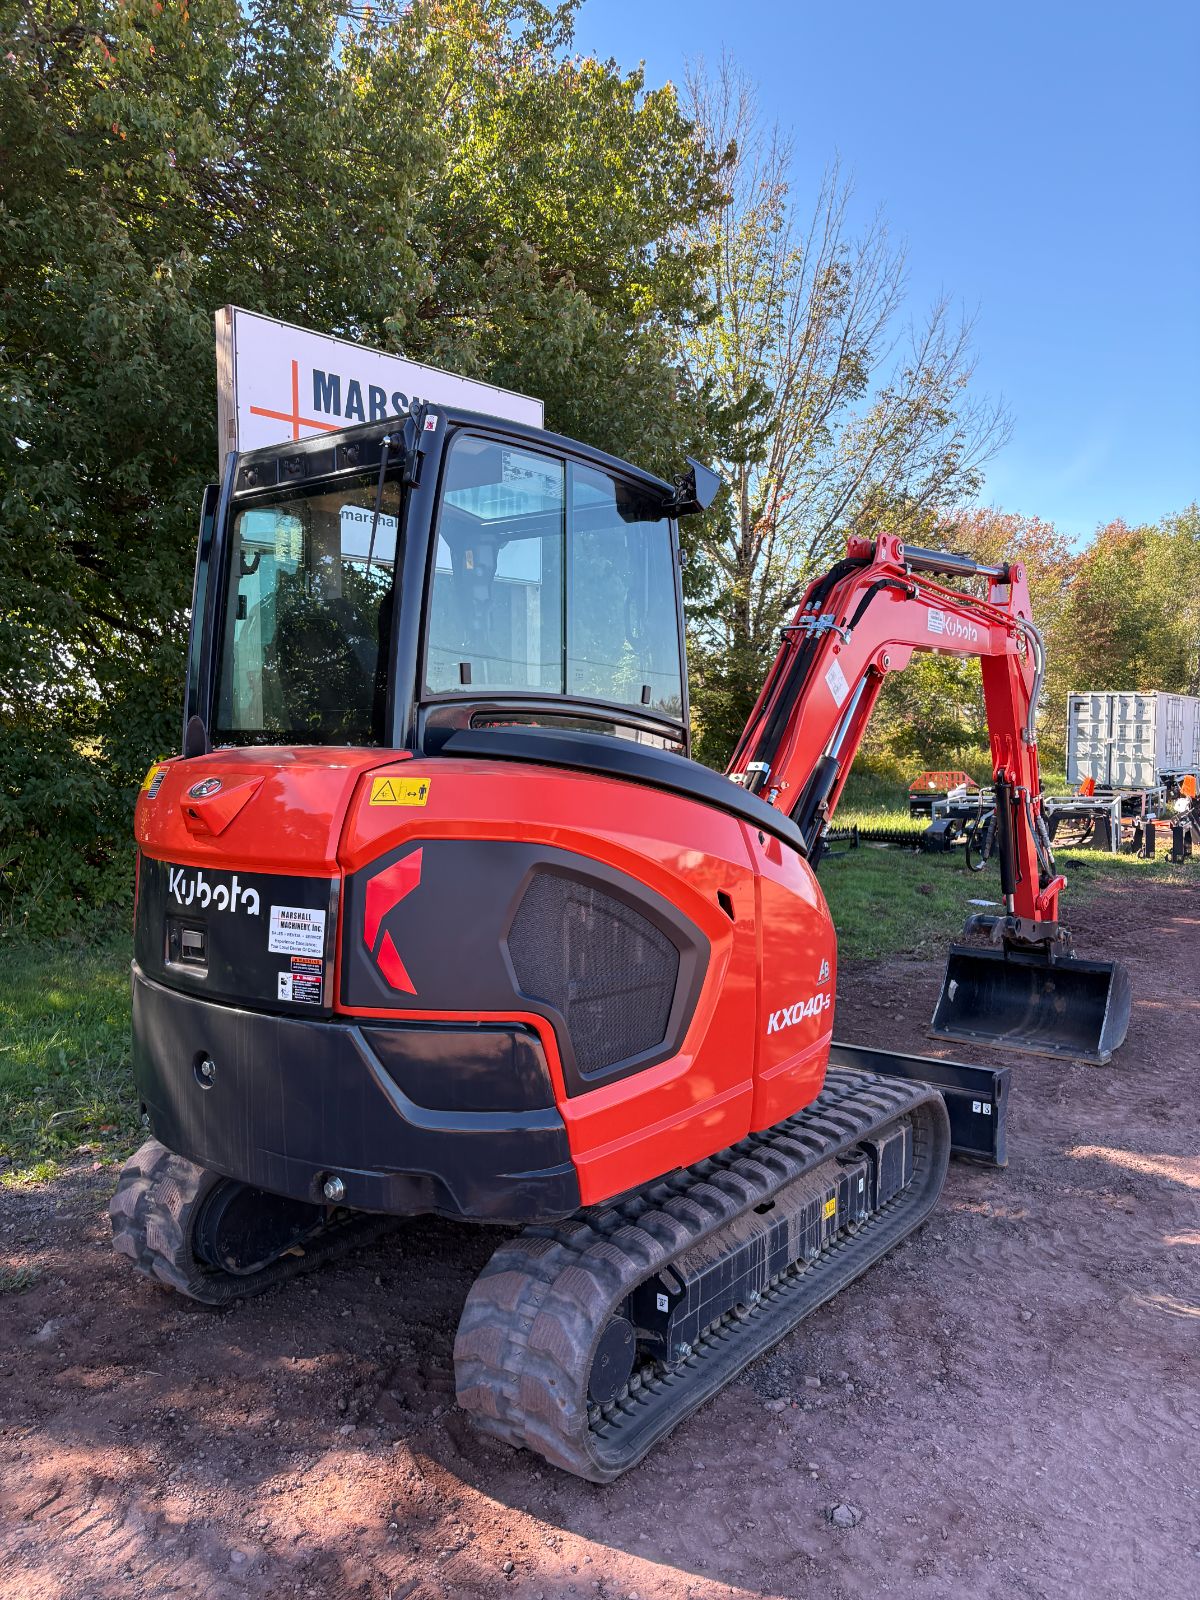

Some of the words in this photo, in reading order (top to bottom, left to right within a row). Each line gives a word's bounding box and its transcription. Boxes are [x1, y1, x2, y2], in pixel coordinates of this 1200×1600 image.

[313, 369, 429, 422] MARS
[944, 615, 978, 642] Kubota
[169, 867, 260, 915] Kubota
[280, 911, 312, 921] MARSHALL
[767, 993, 831, 1035] KX040-5
